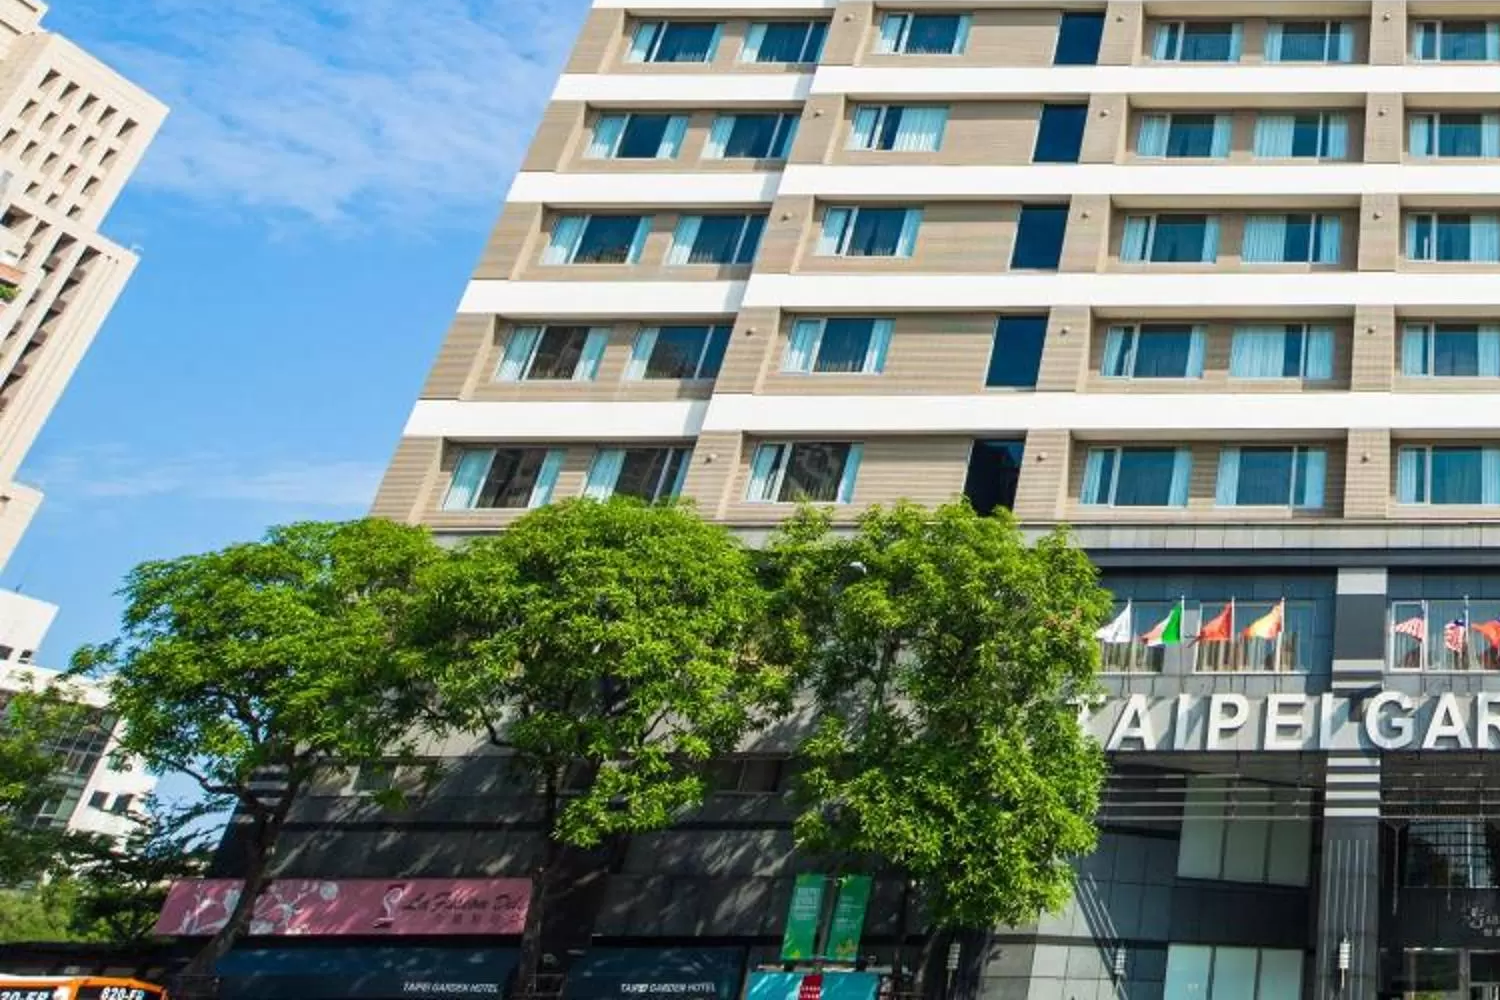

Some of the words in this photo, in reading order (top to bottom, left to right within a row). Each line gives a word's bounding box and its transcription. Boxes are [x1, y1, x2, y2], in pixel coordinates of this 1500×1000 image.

[403, 982, 431, 993] TAIPEI
[431, 983, 469, 993] GARDEN
[469, 983, 499, 993] HOTEL
[687, 983, 716, 993] HOTEL
